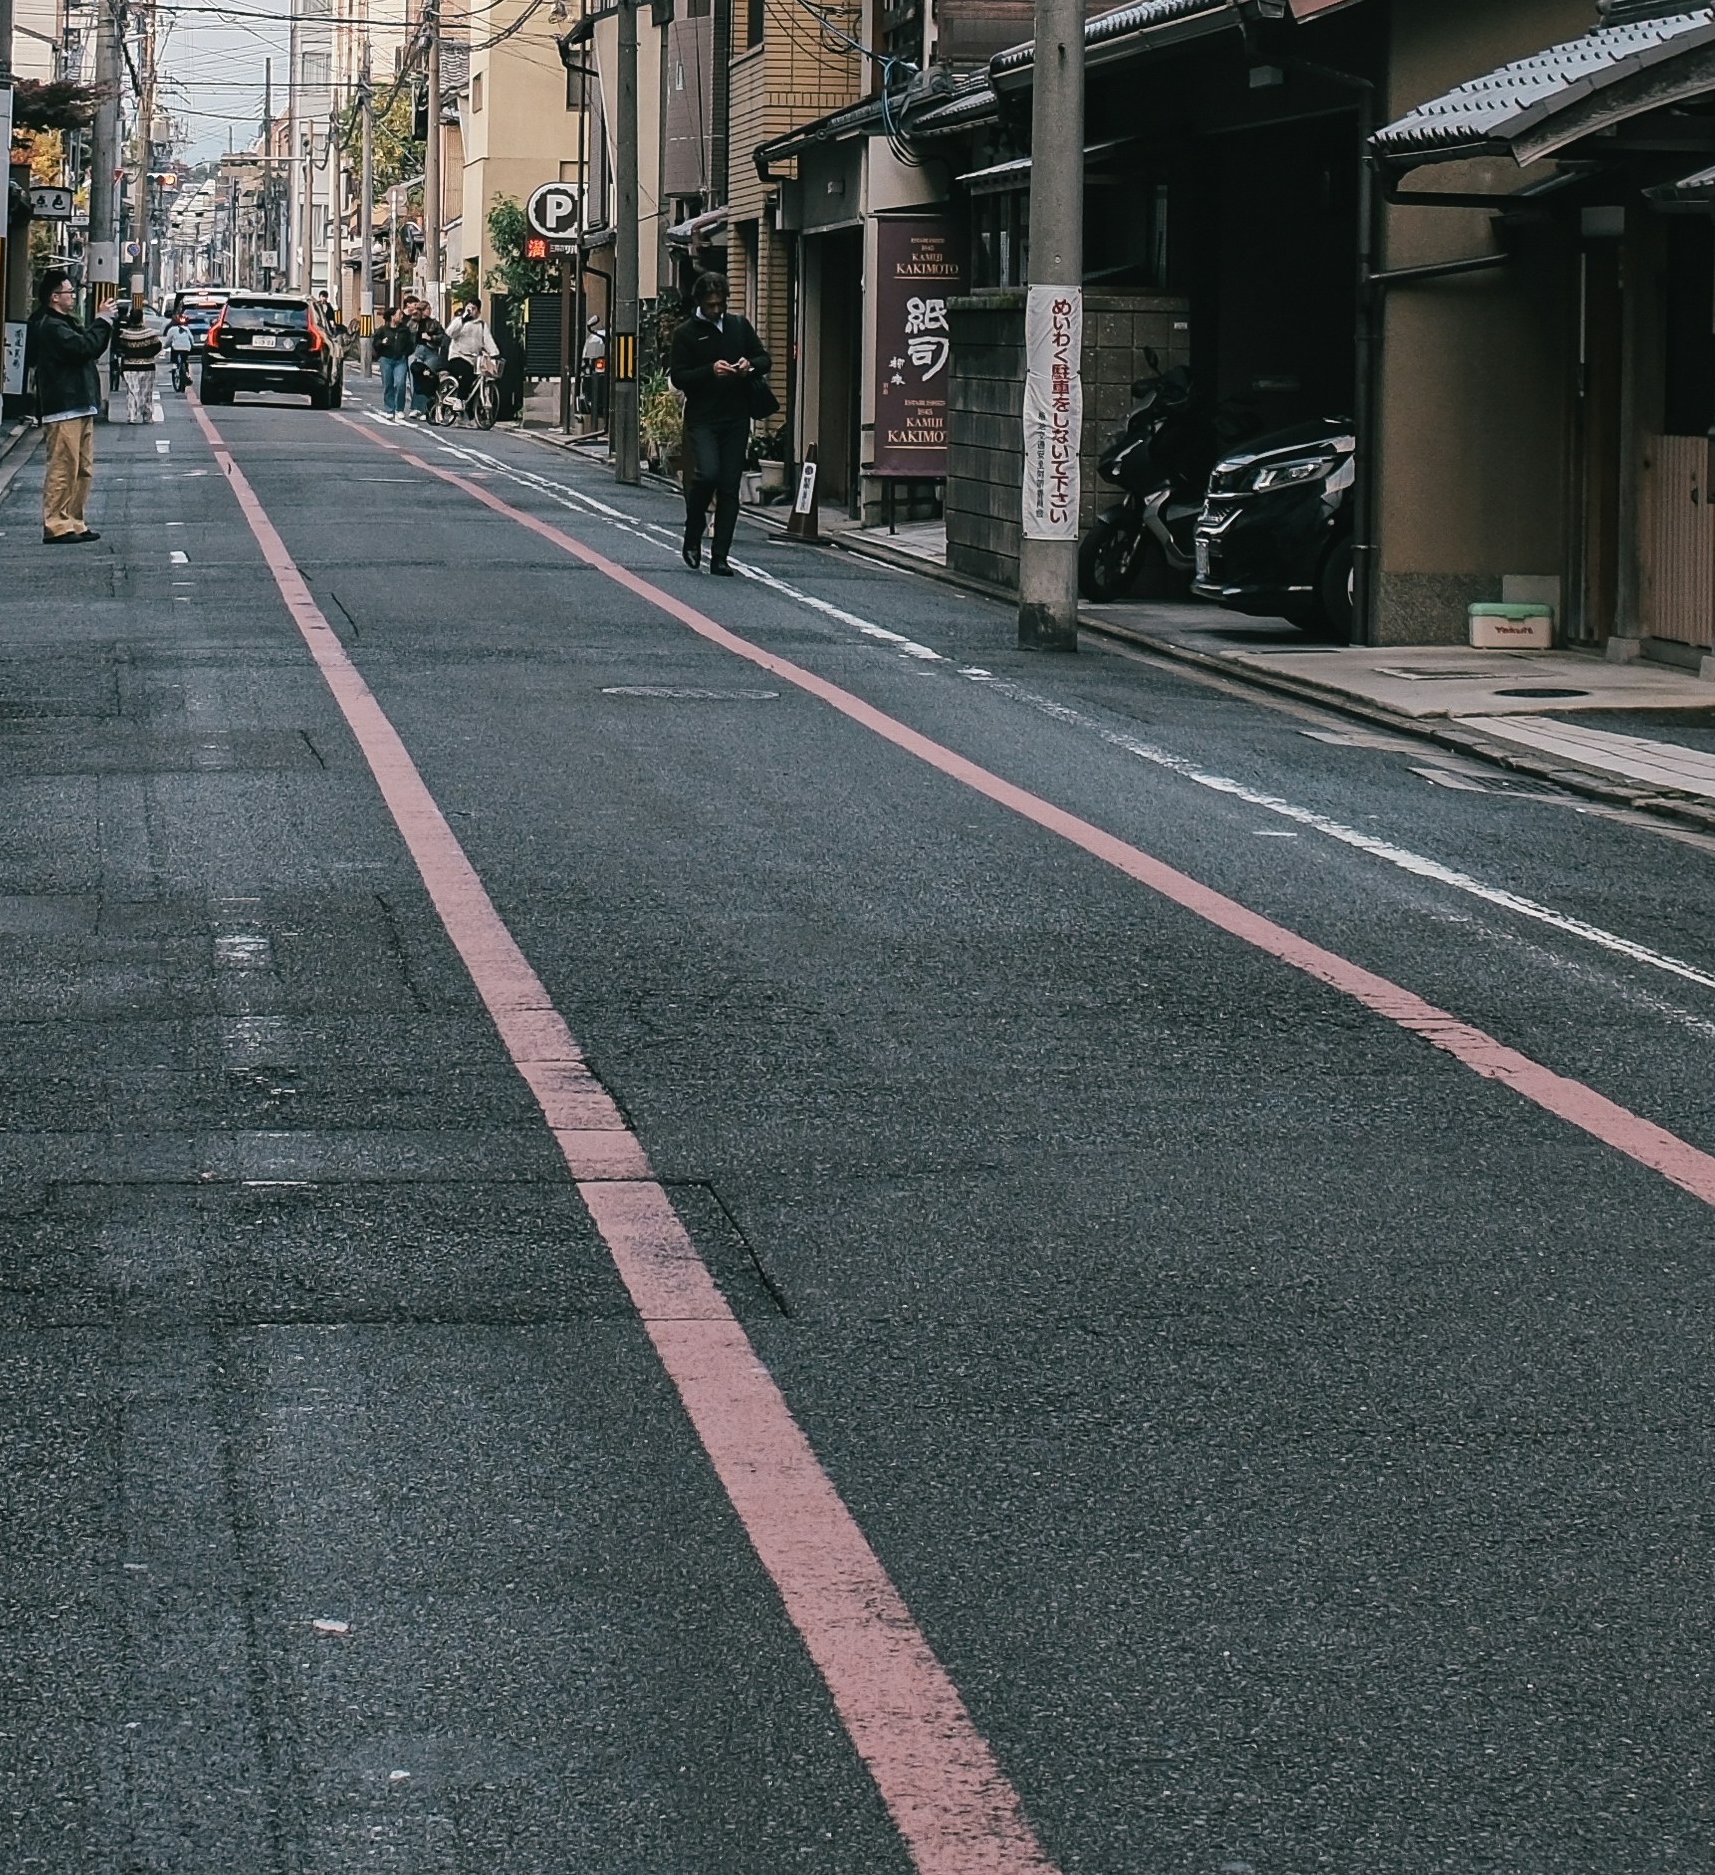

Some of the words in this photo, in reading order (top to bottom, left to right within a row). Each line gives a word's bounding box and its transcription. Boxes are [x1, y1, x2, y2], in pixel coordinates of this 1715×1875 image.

[546, 194, 573, 228] P
[896, 263, 959, 274] KAKIMOTO
[1050, 298, 1072, 524] めいわく駐車をしないで下さい
